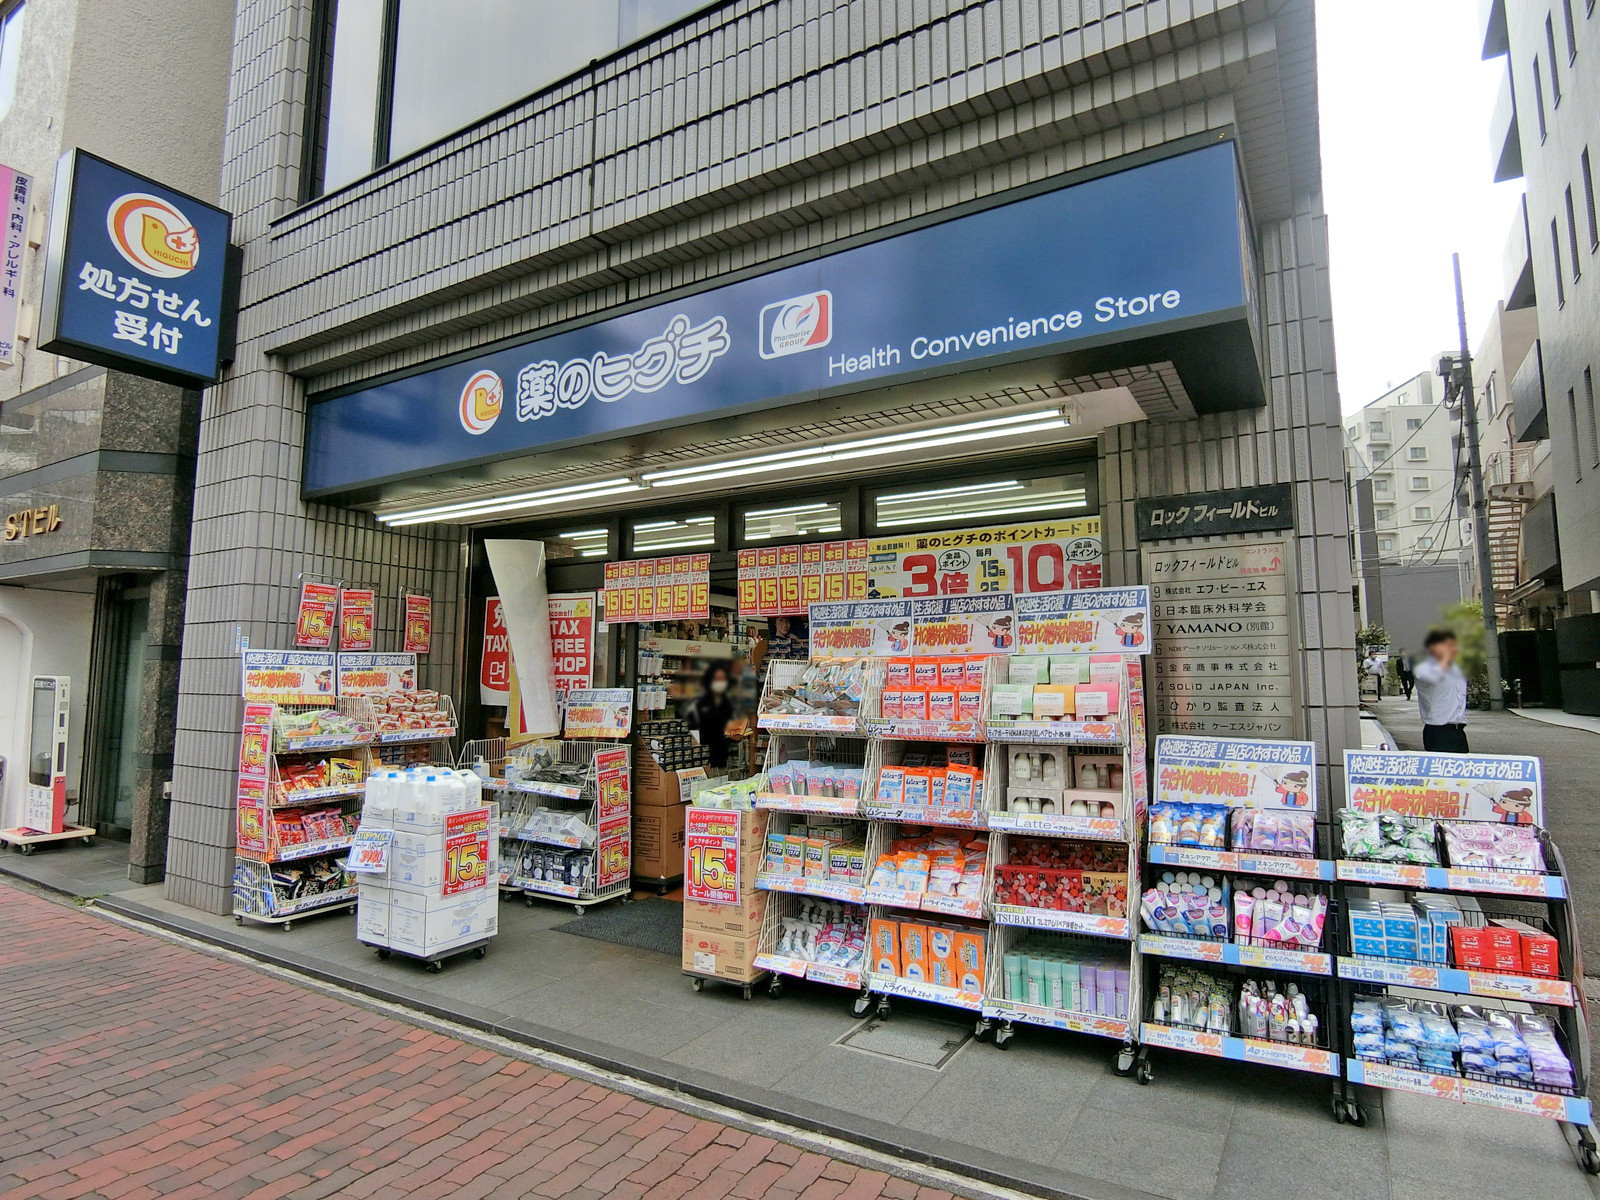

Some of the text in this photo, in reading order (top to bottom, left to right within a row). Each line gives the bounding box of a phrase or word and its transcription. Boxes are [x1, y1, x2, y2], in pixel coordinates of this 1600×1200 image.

[3, 176, 28, 298] 皮膚科・内科・アレルギー科
[153, 248, 189, 267] HIGUCHI
[78, 261, 212, 327] 処方せん
[112, 310, 183, 355] 受付
[773, 328, 811, 345] Pharmarise
[828, 289, 1181, 377] Health Convenience Store
[779, 337, 805, 349] GROUP
[516, 313, 731, 422] 薬のヒグチ
[1150, 499, 1279, 526] ロックフィールドビル
[1074, 541, 1092, 549] 全品
[780, 553, 797, 564] 本日
[803, 551, 819, 561] 本日
[825, 549, 843, 560] 本日
[847, 547, 866, 558] 本日
[945, 552, 962, 560] 全品
[975, 548, 992, 557] 毎月
[1070, 549, 1100, 558] ポイント
[674, 562, 688, 572] 本日
[692, 560, 707, 571] 本日
[739, 557, 755, 566] 本日
[760, 555, 776, 565] 本日
[942, 559, 968, 567] ポイント
[1155, 556, 1239, 573] ロックフィールドビル
[606, 569, 618, 578] 本日
[621, 567, 635, 576] 本日
[639, 566, 653, 575] 本日
[657, 564, 671, 574] 本日
[740, 580, 756, 602] 15
[760, 580, 777, 601] 15
[780, 577, 798, 601] 15
[802, 576, 820, 599] 15
[825, 574, 843, 598] 15
[847, 573, 866, 597] 15
[1153, 581, 1267, 598] 9 株式会社 エフ・ビー・エス
[605, 590, 619, 610] 15
[620, 589, 635, 610] 15
[639, 588, 653, 609] 15
[656, 586, 671, 608] 15
[673, 585, 688, 606] 15
[691, 584, 707, 605] 15
[1154, 602, 1267, 617] 8 日本臨床外科学会
[551, 620, 580, 635] TAX
[1155, 624, 1161, 636] 7
[1166, 622, 1243, 634] YAMANO
[486, 635, 509, 652] TAX
[551, 638, 586, 653] REE
[1155, 643, 1162, 655] 6
[554, 656, 587, 672] HOP
[1156, 662, 1163, 673] 5
[1157, 681, 1164, 693] 4
[1157, 700, 1280, 712] 3 ひかり監査法人
[867, 724, 896, 734] ムシューダ
[1082, 723, 1113, 734] 980
[1158, 719, 1282, 731] 2 株式会社 ケーエスジャパン
[1350, 756, 1533, 779] 快適生活応援！当店のおすすめ品！
[947, 774, 972, 783] ムシューダ
[867, 808, 904, 818] ムシューダ
[1015, 819, 1052, 829] Latte
[1087, 818, 1118, 830] 1600
[447, 842, 487, 885] 15倍
[689, 845, 736, 891] 15倍
[996, 913, 1036, 925] TSUBAKI
[1340, 965, 1385, 980] 牛乳石鹸
[882, 981, 917, 995] ドライペット
[995, 1009, 1027, 1021] ケープ
[1092, 1020, 1127, 1033] 598
